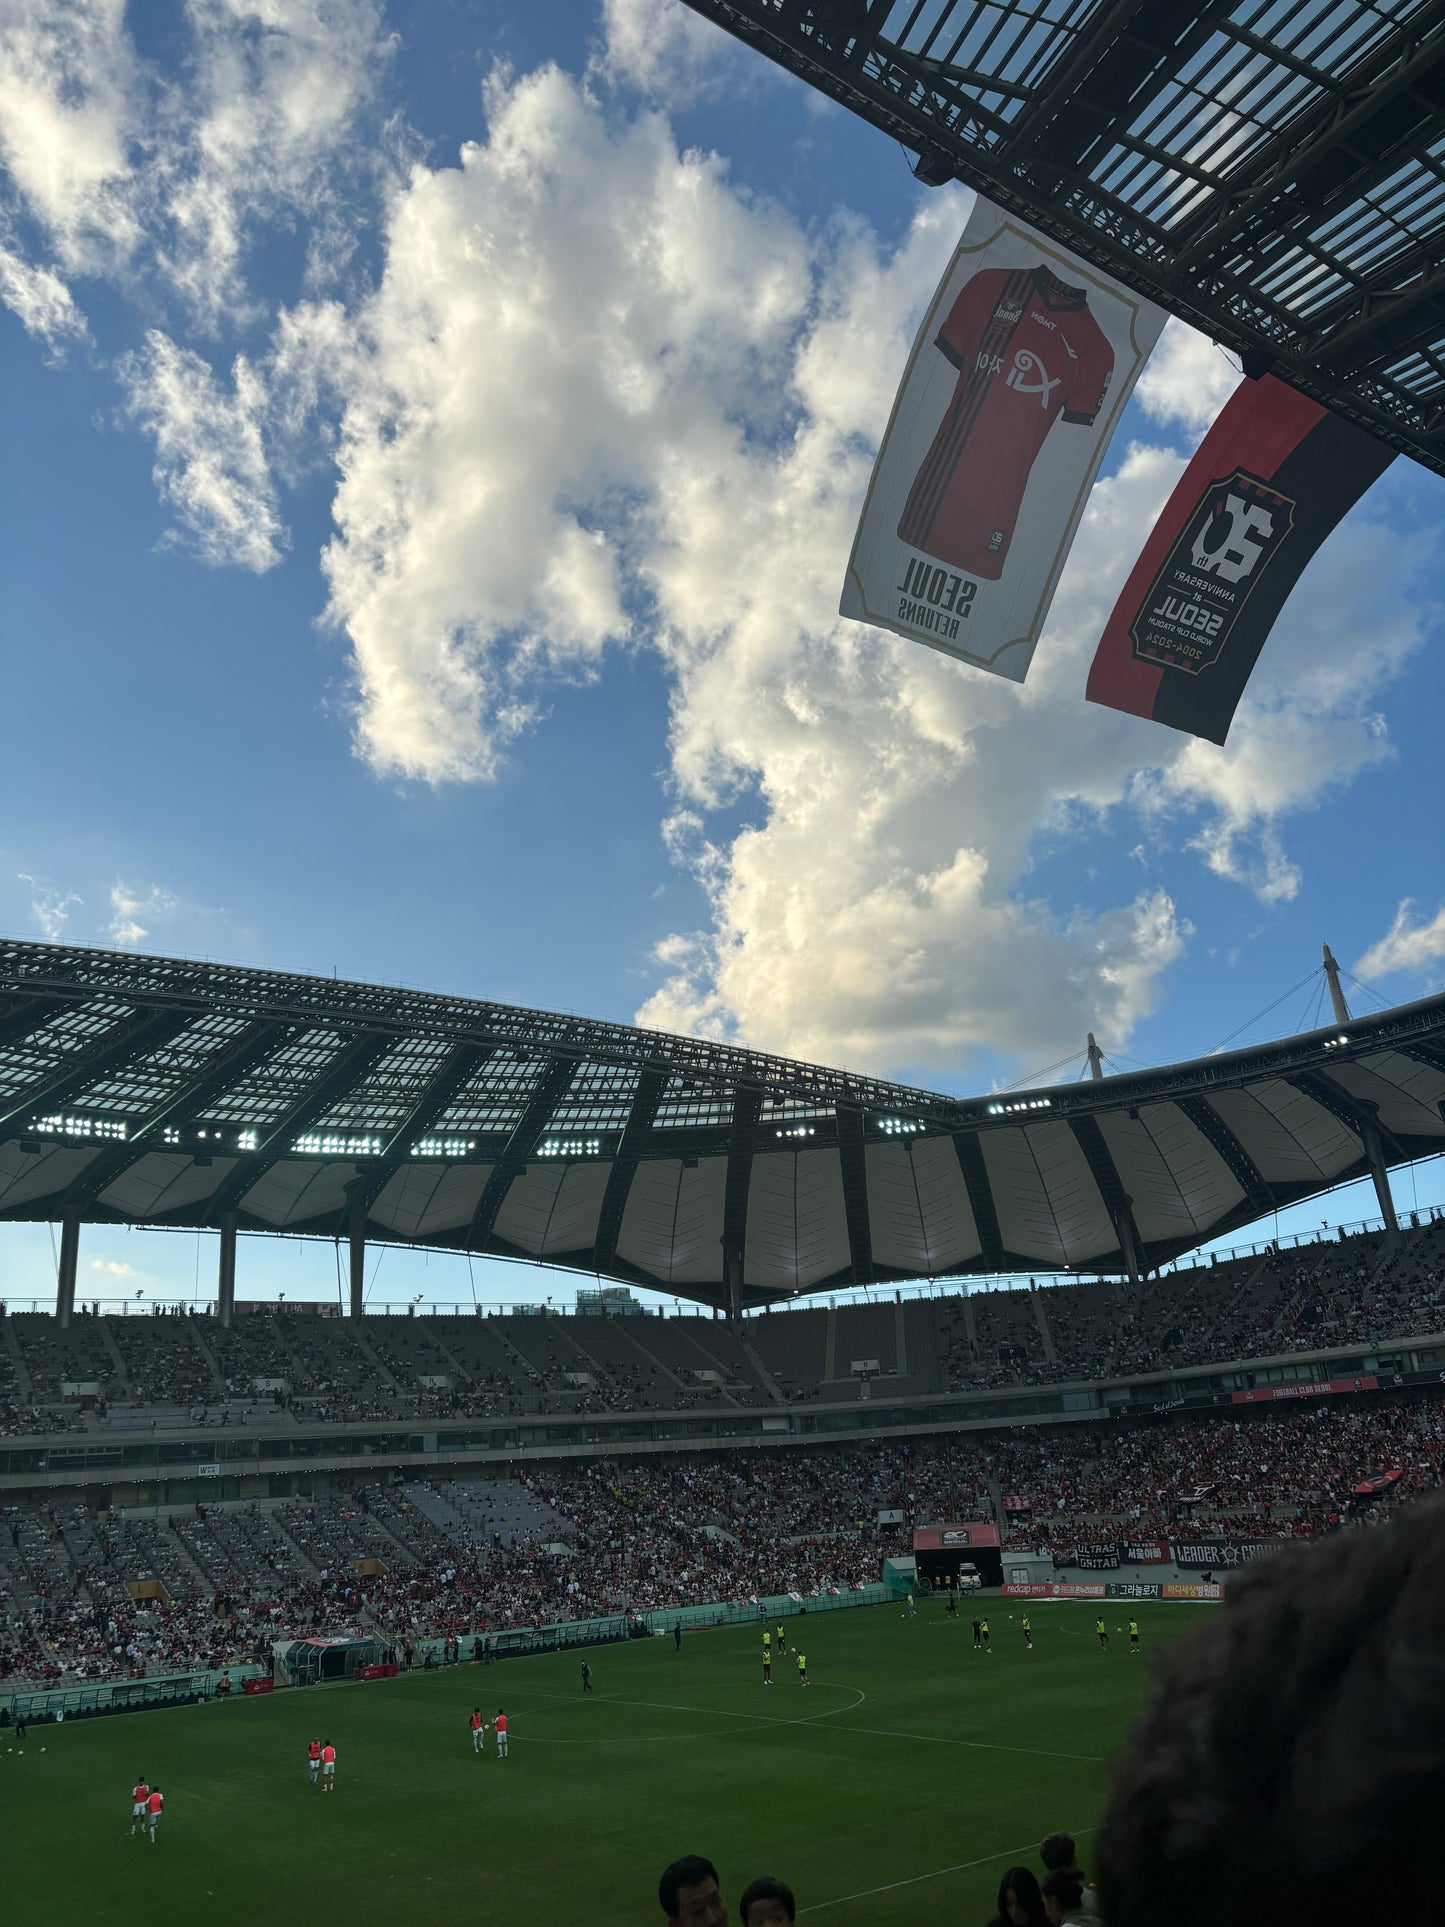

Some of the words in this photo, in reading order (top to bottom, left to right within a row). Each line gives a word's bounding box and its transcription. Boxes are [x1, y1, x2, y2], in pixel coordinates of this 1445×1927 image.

[76, 1384, 82, 1392] T
[1272, 1386, 1299, 1397] FOOTBALL
[1299, 1385, 1313, 1395] CLUB
[1314, 1383, 1332, 1393] SEOUL
[889, 1512, 895, 1520] A
[1078, 1542, 1115, 1554] ULTRAS
[1177, 1545, 1221, 1563] LEADER
[1007, 1584, 1031, 1595] redcap
[1119, 1584, 1158, 1597] 그라놀로지
